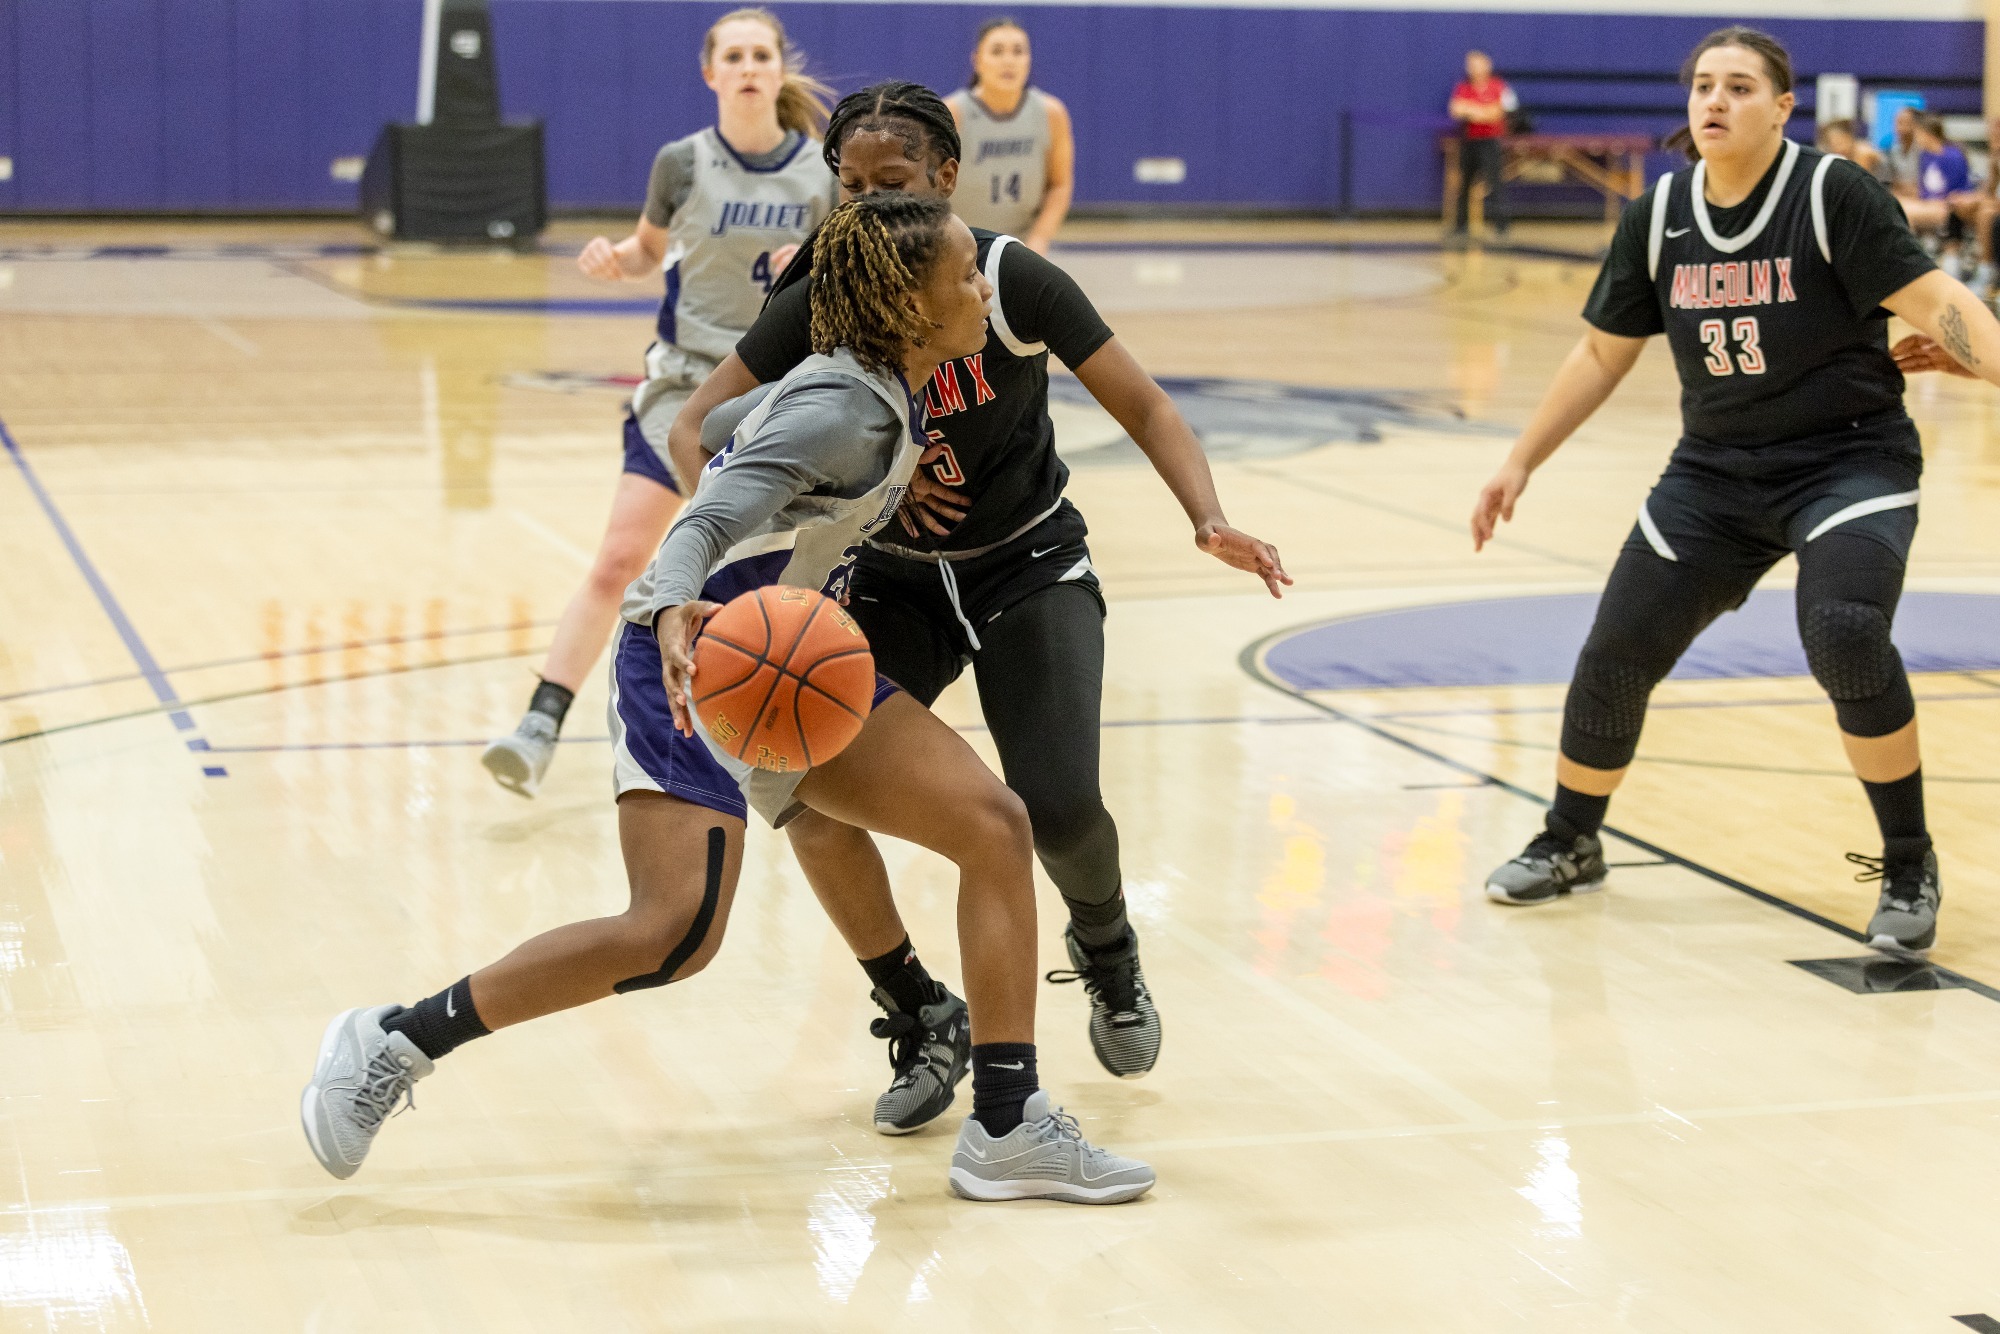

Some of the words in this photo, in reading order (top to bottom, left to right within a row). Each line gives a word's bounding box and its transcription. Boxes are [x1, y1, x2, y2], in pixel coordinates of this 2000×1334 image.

[990, 172, 1021, 204] 14
[711, 202, 809, 238] JOLIET
[751, 251, 773, 293] 4
[1670, 259, 1772, 309] MALCOLM
[1775, 257, 1797, 303] X
[1700, 316, 1767, 377] 33
[963, 352, 996, 406] X
